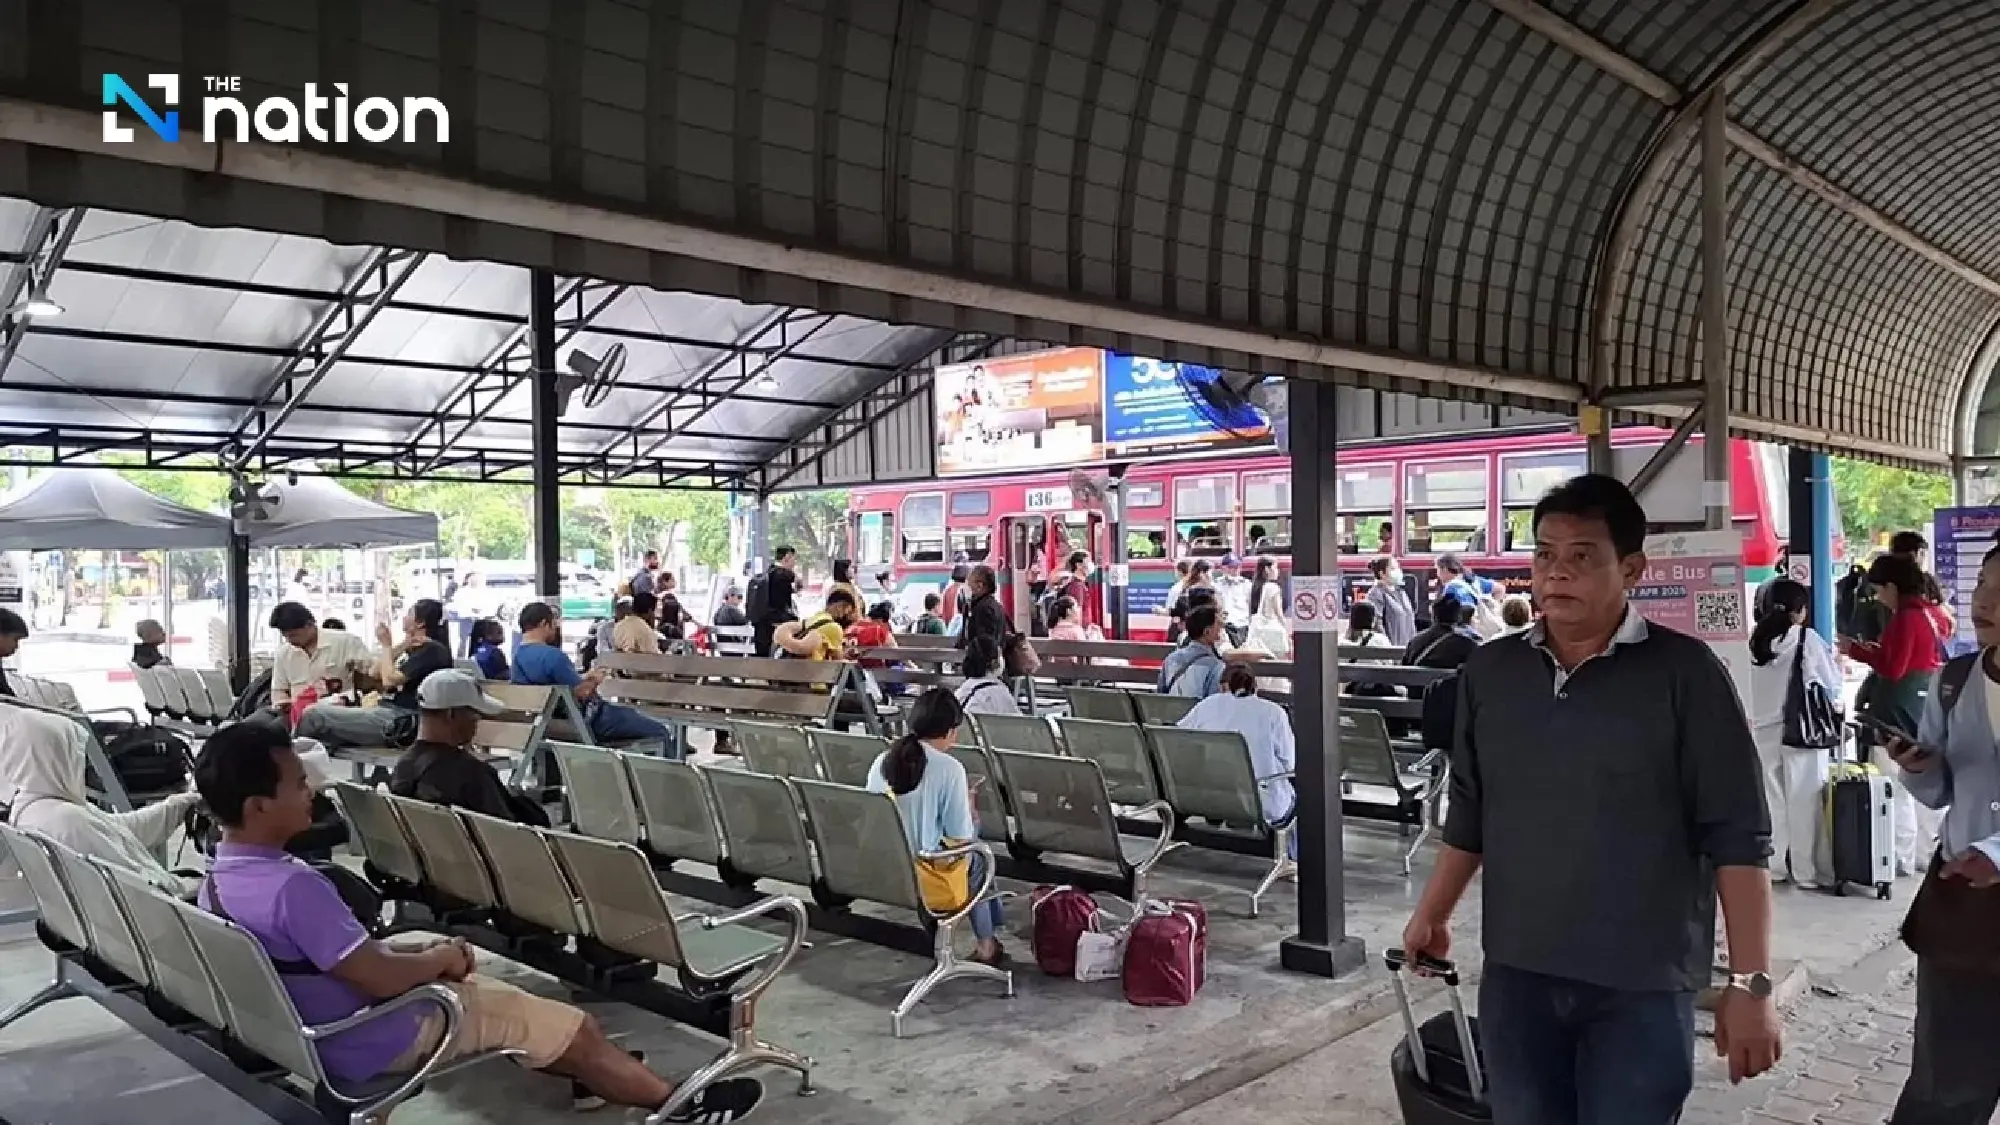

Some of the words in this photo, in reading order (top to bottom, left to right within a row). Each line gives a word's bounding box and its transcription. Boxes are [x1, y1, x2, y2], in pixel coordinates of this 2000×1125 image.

[1028, 491, 1053, 507] 136
[1642, 565, 1666, 580] tle
[1673, 565, 1706, 579] Bus
